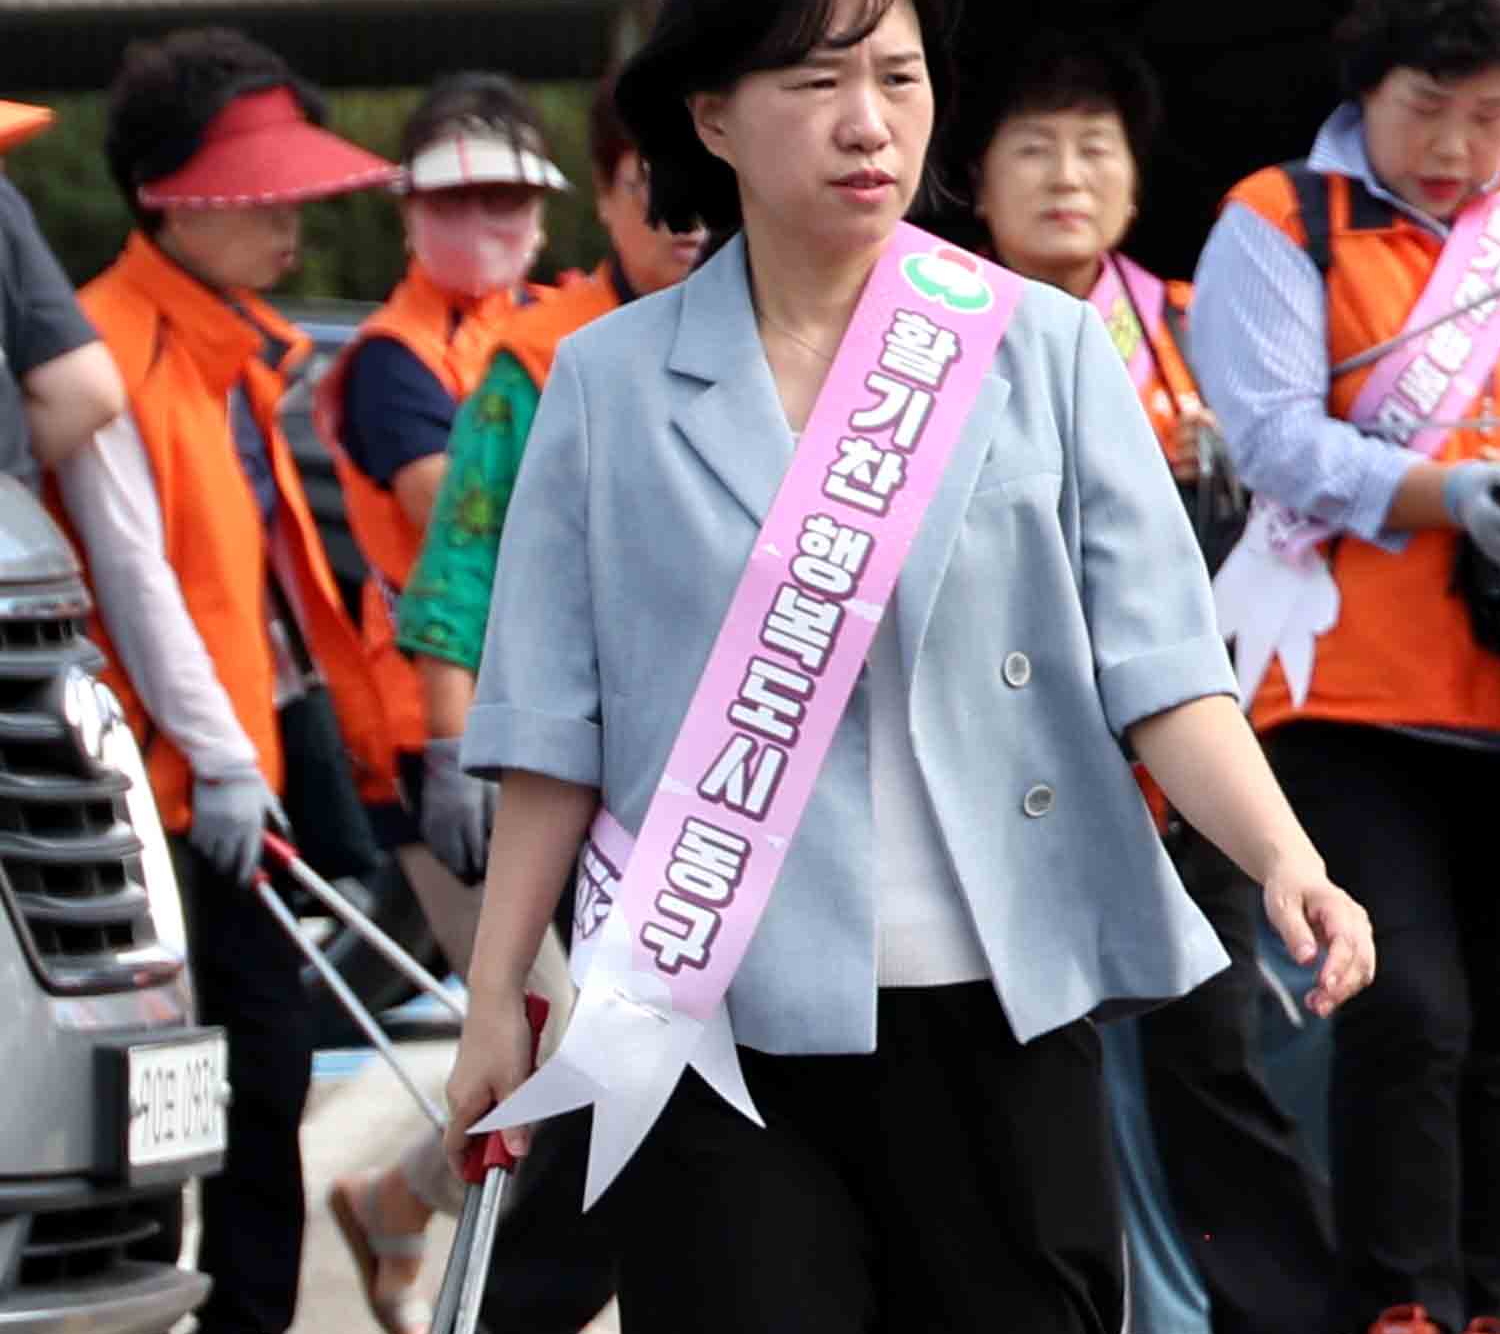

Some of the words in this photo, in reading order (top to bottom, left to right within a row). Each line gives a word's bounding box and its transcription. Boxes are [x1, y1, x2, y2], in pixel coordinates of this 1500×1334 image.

[825, 308, 964, 517] 활기찬
[698, 513, 876, 823] 행복도시
[640, 814, 751, 975] 동구
